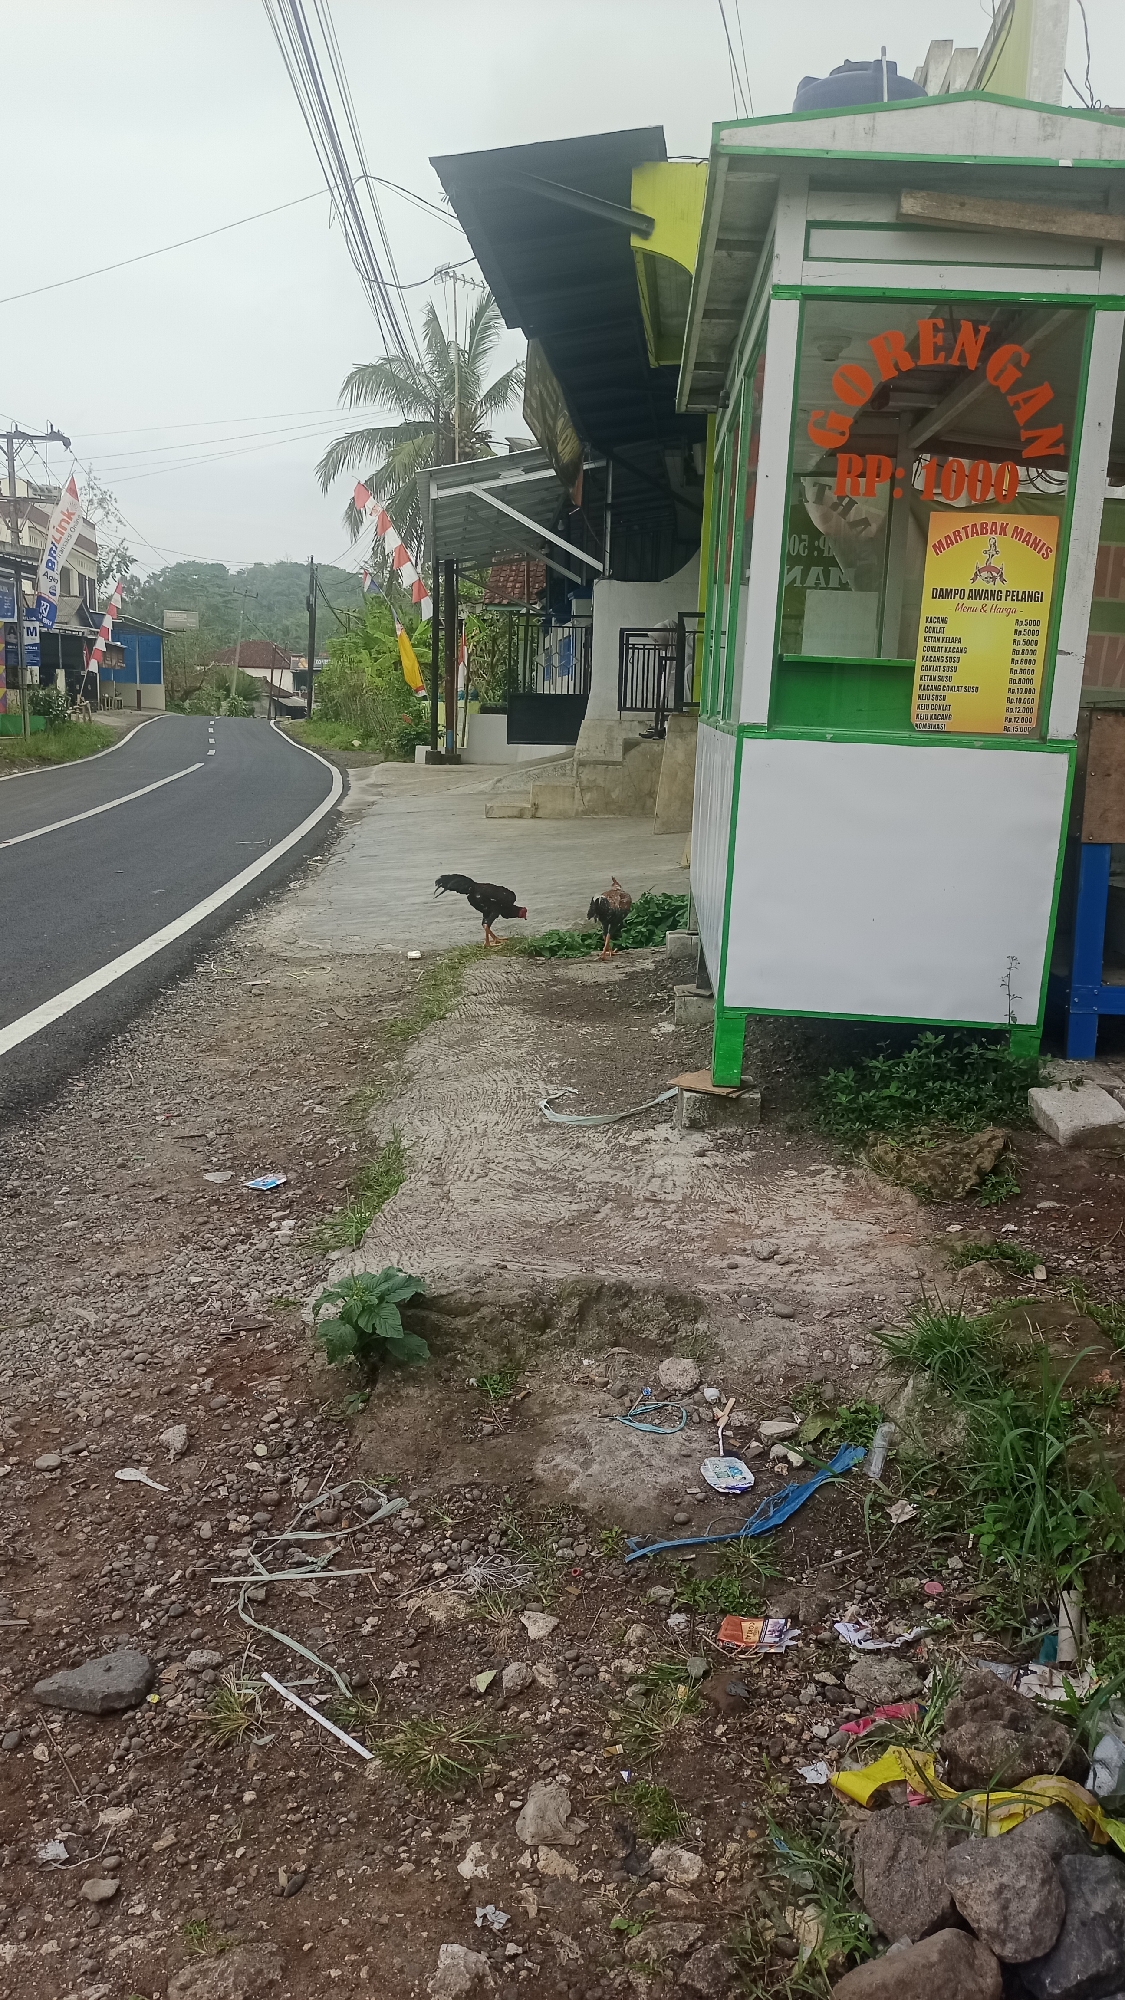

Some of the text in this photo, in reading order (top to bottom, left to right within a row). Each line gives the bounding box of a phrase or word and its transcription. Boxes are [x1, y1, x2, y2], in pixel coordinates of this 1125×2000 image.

[807, 318, 1065, 459] GORENGAN
[833, 453, 1019, 504] RP: 1000
[931, 521, 1053, 560] MARTABAK MANIS
[931, 587, 1044, 603] DAMPO AWANG PELANGI
[955, 602, 1017, 617] Menu & Harga
[1015, 619, 1041, 627] Rp.5000
[1014, 629, 1040, 637] Rp.5000
[1012, 639, 1039, 647] Rp.5000
